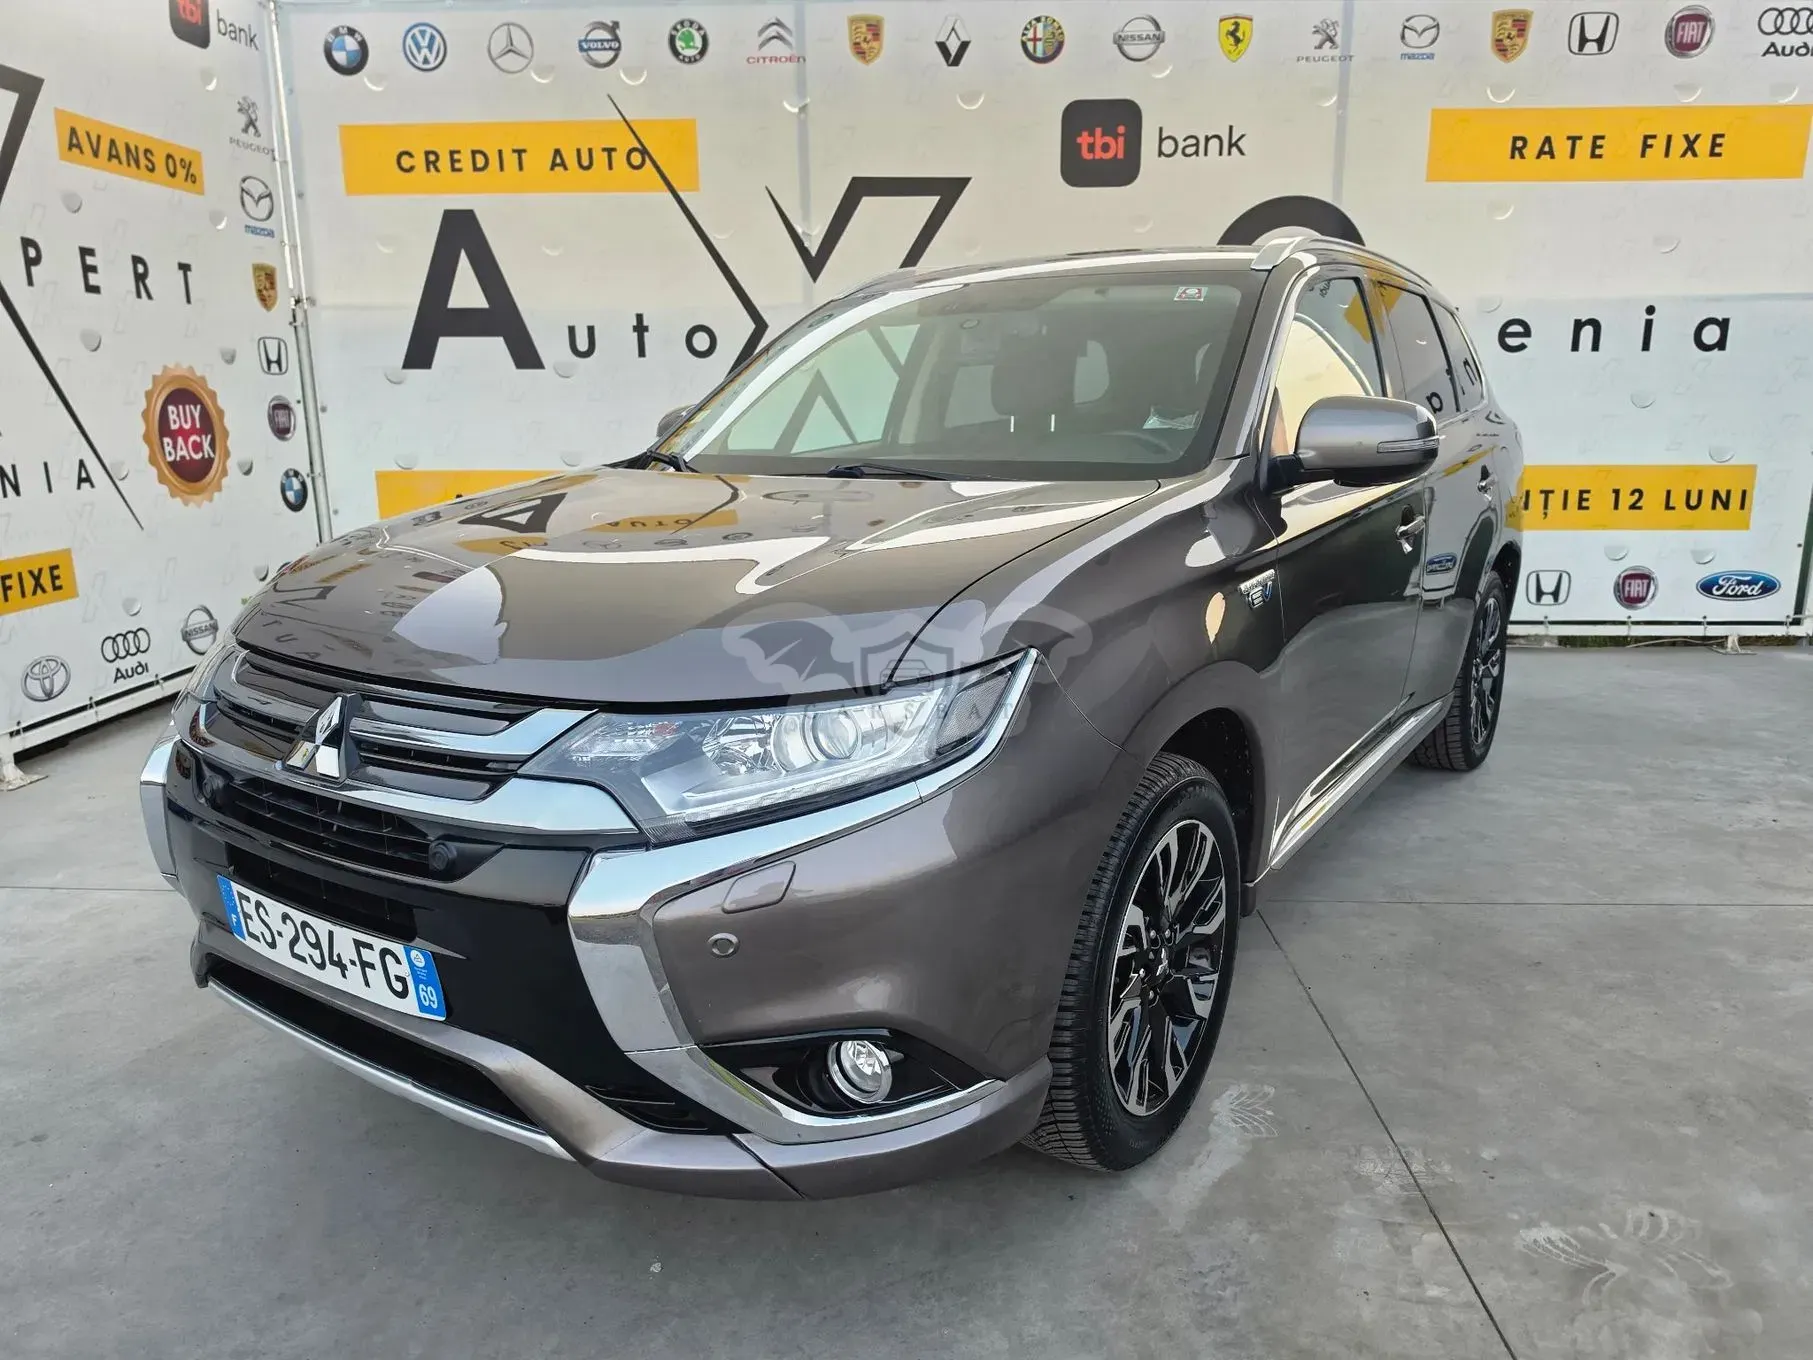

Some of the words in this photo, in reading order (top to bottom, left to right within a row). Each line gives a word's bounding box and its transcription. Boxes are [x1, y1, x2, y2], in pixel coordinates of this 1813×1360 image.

[216, 8, 259, 51] bank
[1117, 33, 1162, 43] NISSAN
[1676, 21, 1705, 44] FIAT
[580, 40, 620, 50] VOLVO
[1400, 52, 1436, 61] mazda
[1296, 54, 1355, 63] PEUGEOT
[67, 126, 156, 173] AVANS
[165, 152, 197, 184] 0%
[1076, 125, 1126, 160] tbi
[1157, 125, 1247, 159] bank
[1509, 135, 1606, 160] RATE
[1640, 133, 1726, 158] FIXE
[395, 149, 528, 173] CREDIT
[549, 146, 648, 171] AUTO
[168, 404, 201, 430] BUY
[162, 434, 215, 462] BACK
[1612, 488, 1644, 511] 12
[1664, 488, 1748, 511] LUNI
[1, 564, 63, 602] FIXE
[1624, 579, 1650, 598] FIAT
[1712, 574, 1763, 596] Ford
[113, 661, 149, 684] Audi
[236, 889, 410, 1000] ES-294-FG
[419, 983, 438, 1009] 69
